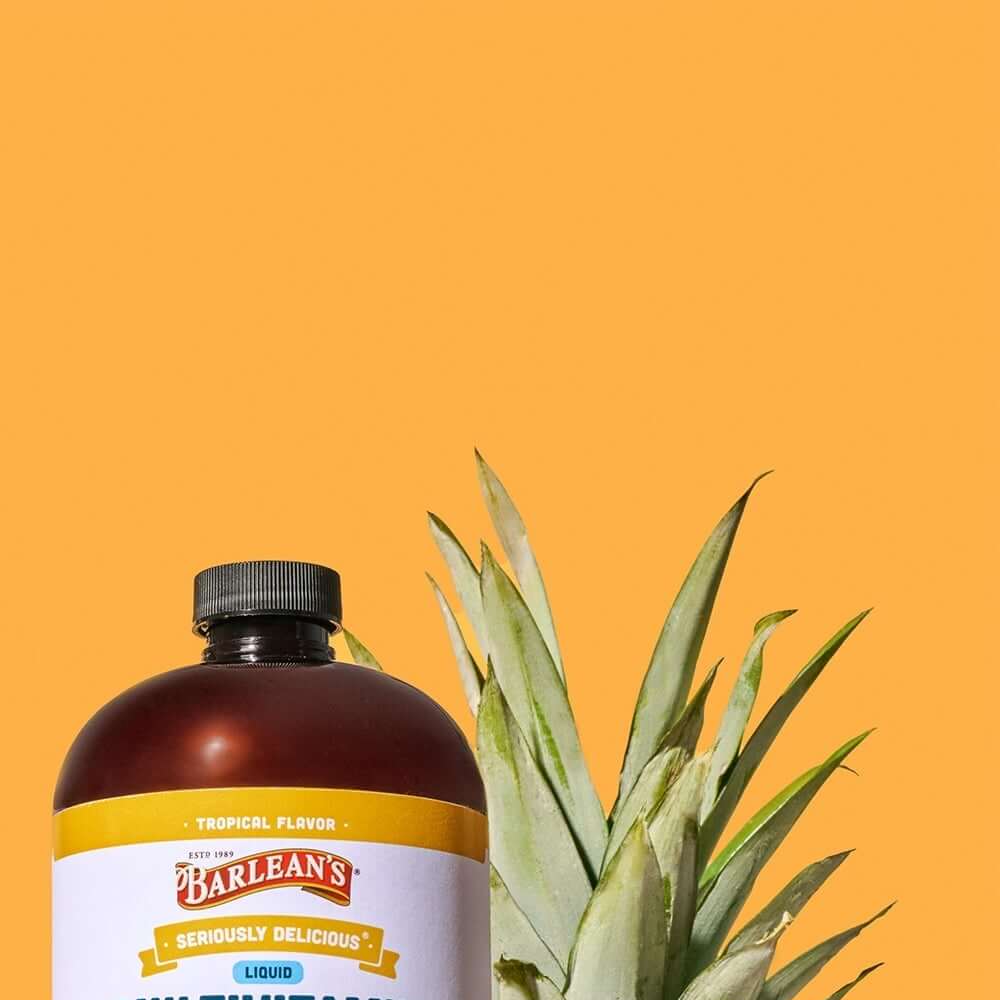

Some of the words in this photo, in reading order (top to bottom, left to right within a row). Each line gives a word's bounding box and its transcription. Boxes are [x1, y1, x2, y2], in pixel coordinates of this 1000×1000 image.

[196, 817, 270, 831] TROPICAL
[276, 817, 336, 831] FLAVOR
[214, 850, 234, 858] 1989
[175, 852, 346, 905] BARLEAN'S
[176, 926, 268, 949] SERIOUSLY
[244, 966, 293, 980] LIQUID
